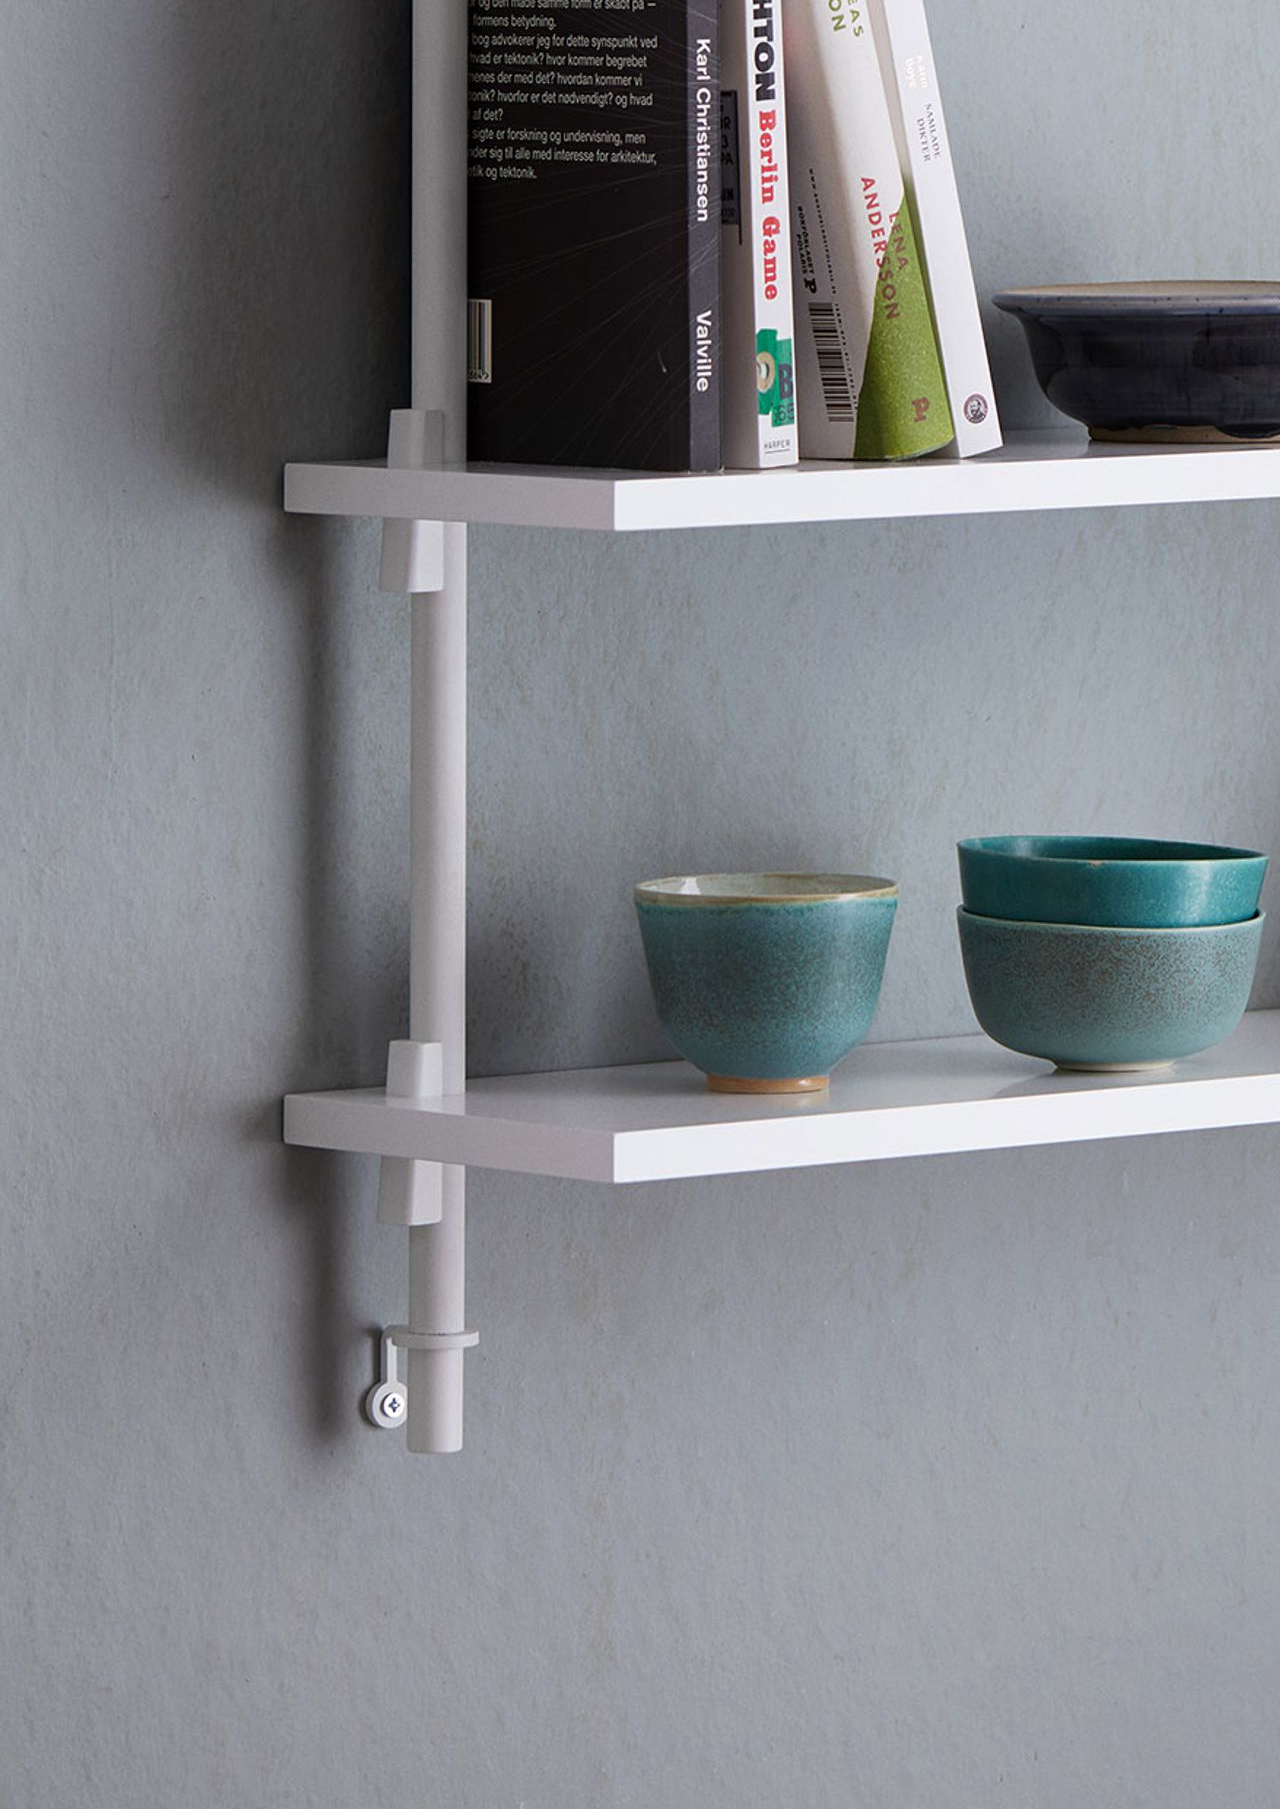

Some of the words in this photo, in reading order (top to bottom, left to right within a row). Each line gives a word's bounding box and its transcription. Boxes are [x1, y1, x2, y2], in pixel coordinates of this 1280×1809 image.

[511, 15, 557, 30] betydning.
[491, 34, 535, 47] advokerer
[536, 34, 550, 50] jeg
[552, 34, 565, 47] for
[566, 34, 590, 48] dette
[591, 35, 639, 51] synspunkt
[640, 36, 658, 48] ved
[493, 54, 502, 65] er
[503, 52, 544, 66] tektonik?
[545, 53, 566, 66] hvor
[568, 54, 604, 66] kommer
[606, 54, 648, 70] begrebet
[695, 38, 712, 82] Karl
[497, 72, 512, 84] der
[514, 72, 533, 84] med
[535, 72, 555, 84] det?
[556, 72, 594, 85] hvordan
[595, 73, 633, 86] kommer
[497, 90, 529, 102] hvorfor
[530, 92, 540, 103] er
[541, 90, 556, 103] det
[614, 95, 627, 108] og
[629, 94, 653, 106] hvad
[483, 108, 503, 120] det?
[496, 130, 505, 140] er
[506, 128, 548, 144] forskning
[549, 131, 561, 145] og
[563, 130, 623, 145] undervisning,
[625, 133, 646, 144] men
[916, 117, 931, 162] DIKTER
[924, 102, 941, 159] SAMLADE
[489, 147, 503, 162] sig
[504, 147, 514, 159] til
[514, 147, 531, 159] alle
[532, 147, 552, 159] med
[554, 148, 594, 162] interesse
[596, 148, 608, 161] for
[610, 148, 657, 166] arkitektur,
[695, 87, 712, 223] Christiansen
[758, 109, 777, 204] Berlin
[485, 167, 498, 180] og
[499, 166, 538, 179] tektonik.
[797, 206, 815, 275] BOKFÖRLAGET
[860, 176, 902, 320] ANDERSSON
[888, 211, 909, 273] LENA
[761, 215, 780, 301] Game
[796, 233, 808, 275] POLARIS
[803, 277, 818, 295] P
[695, 310, 713, 392] Valville
[911, 397, 931, 423] P
[763, 438, 791, 450] HARPER
